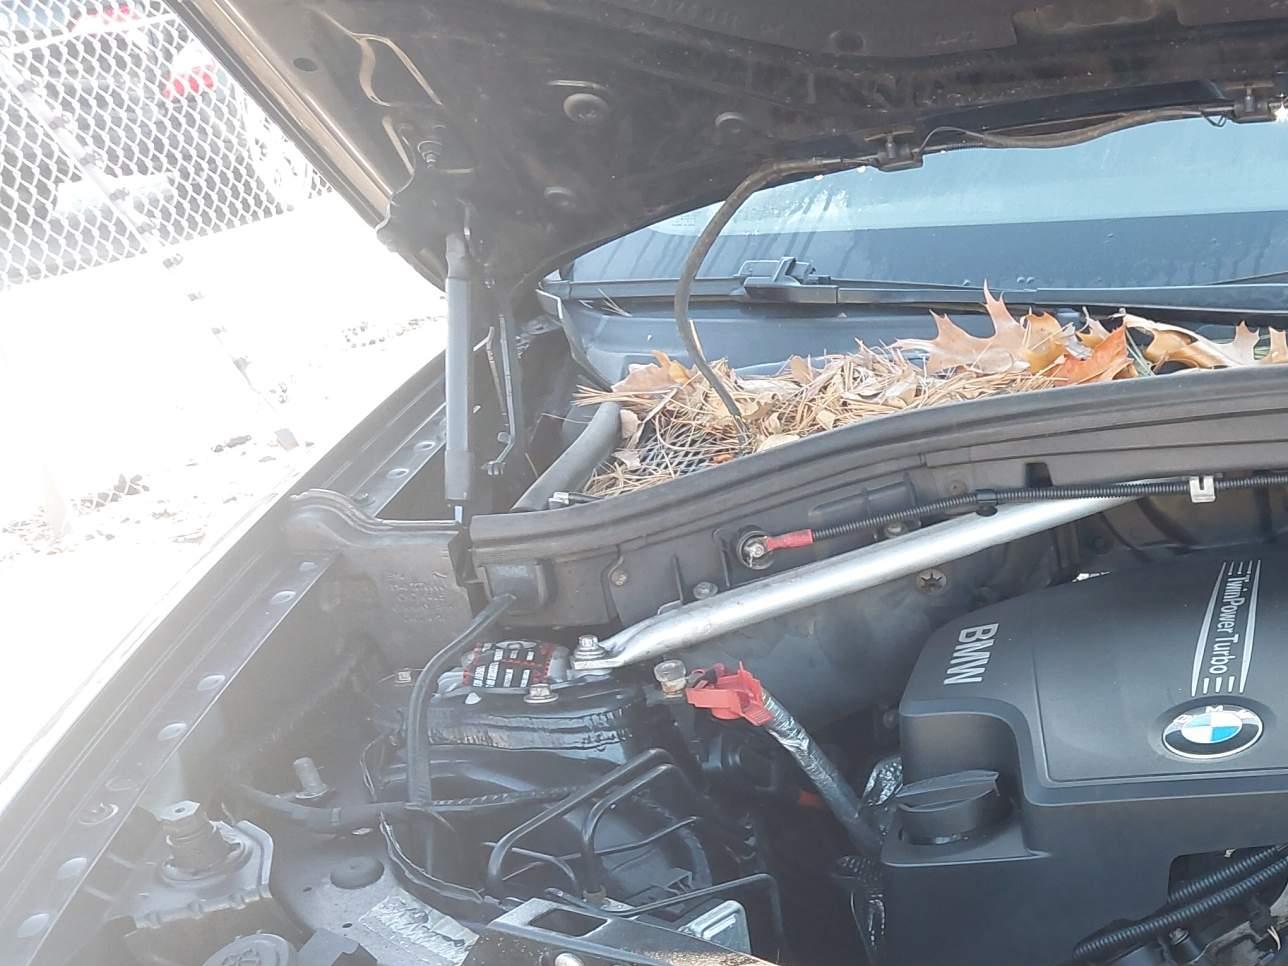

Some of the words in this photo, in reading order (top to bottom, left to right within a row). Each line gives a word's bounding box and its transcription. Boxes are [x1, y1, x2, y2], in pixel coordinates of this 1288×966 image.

[1217, 574, 1251, 633] TwinPower
[943, 623, 999, 685] BMW
[1209, 634, 1239, 674] Turbo
